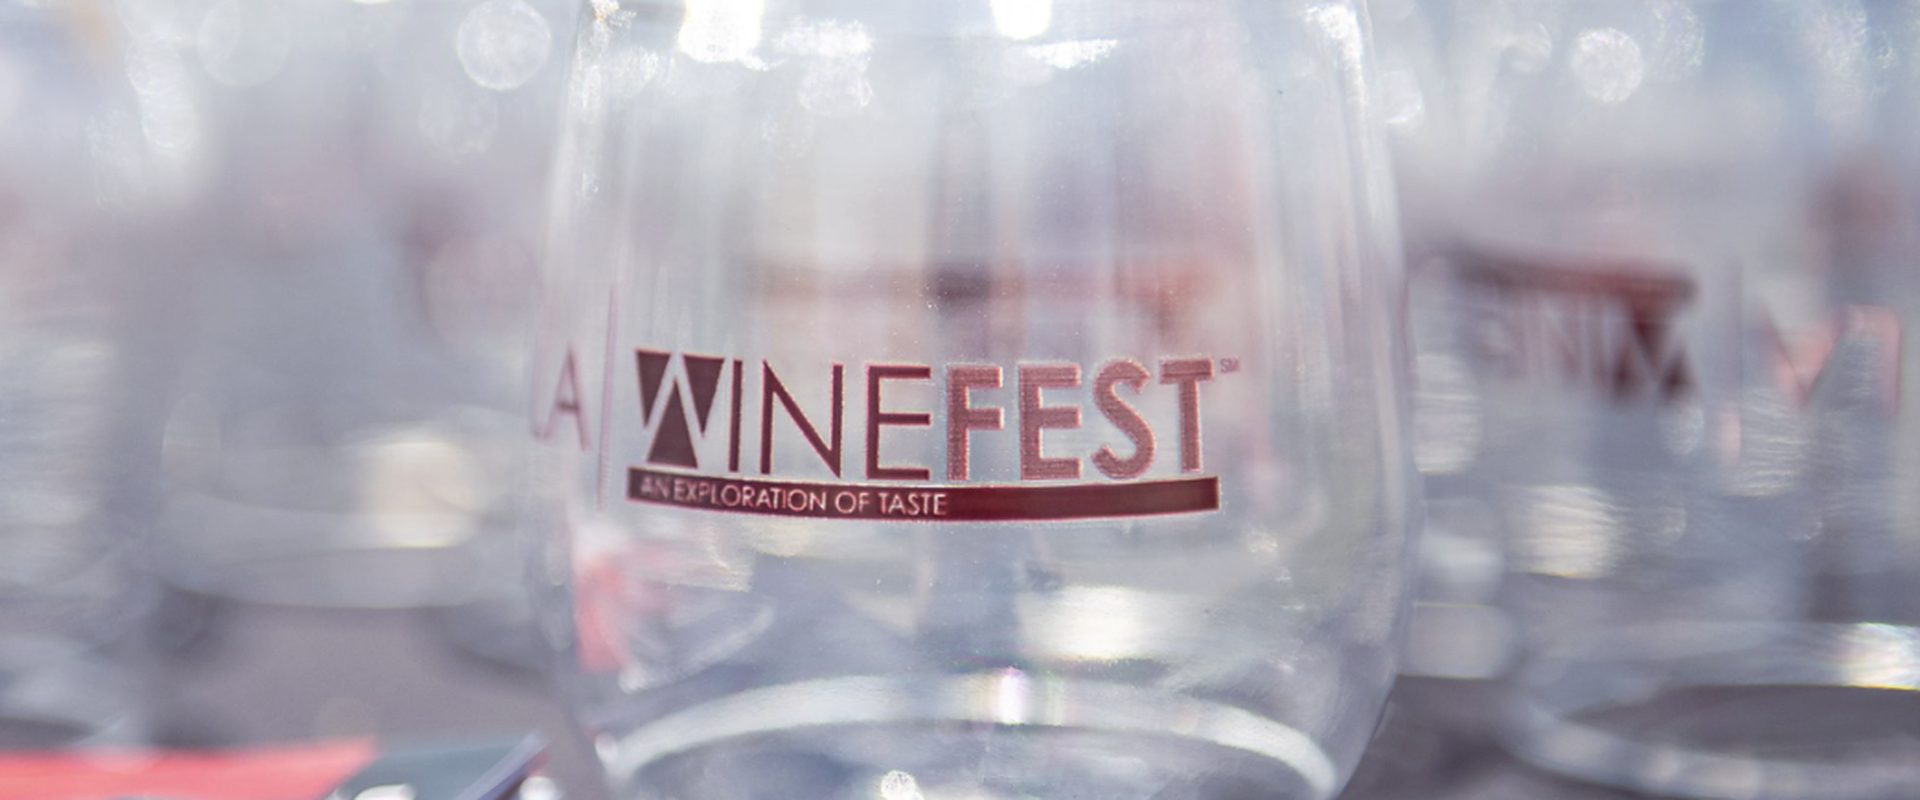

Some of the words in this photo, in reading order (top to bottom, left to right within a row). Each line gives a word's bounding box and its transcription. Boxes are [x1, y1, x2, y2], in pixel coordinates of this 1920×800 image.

[640, 475, 671, 499] AN
[673, 478, 827, 513] EXPLORATION
[835, 490, 870, 514] OF
[878, 491, 948, 516] TASTE
